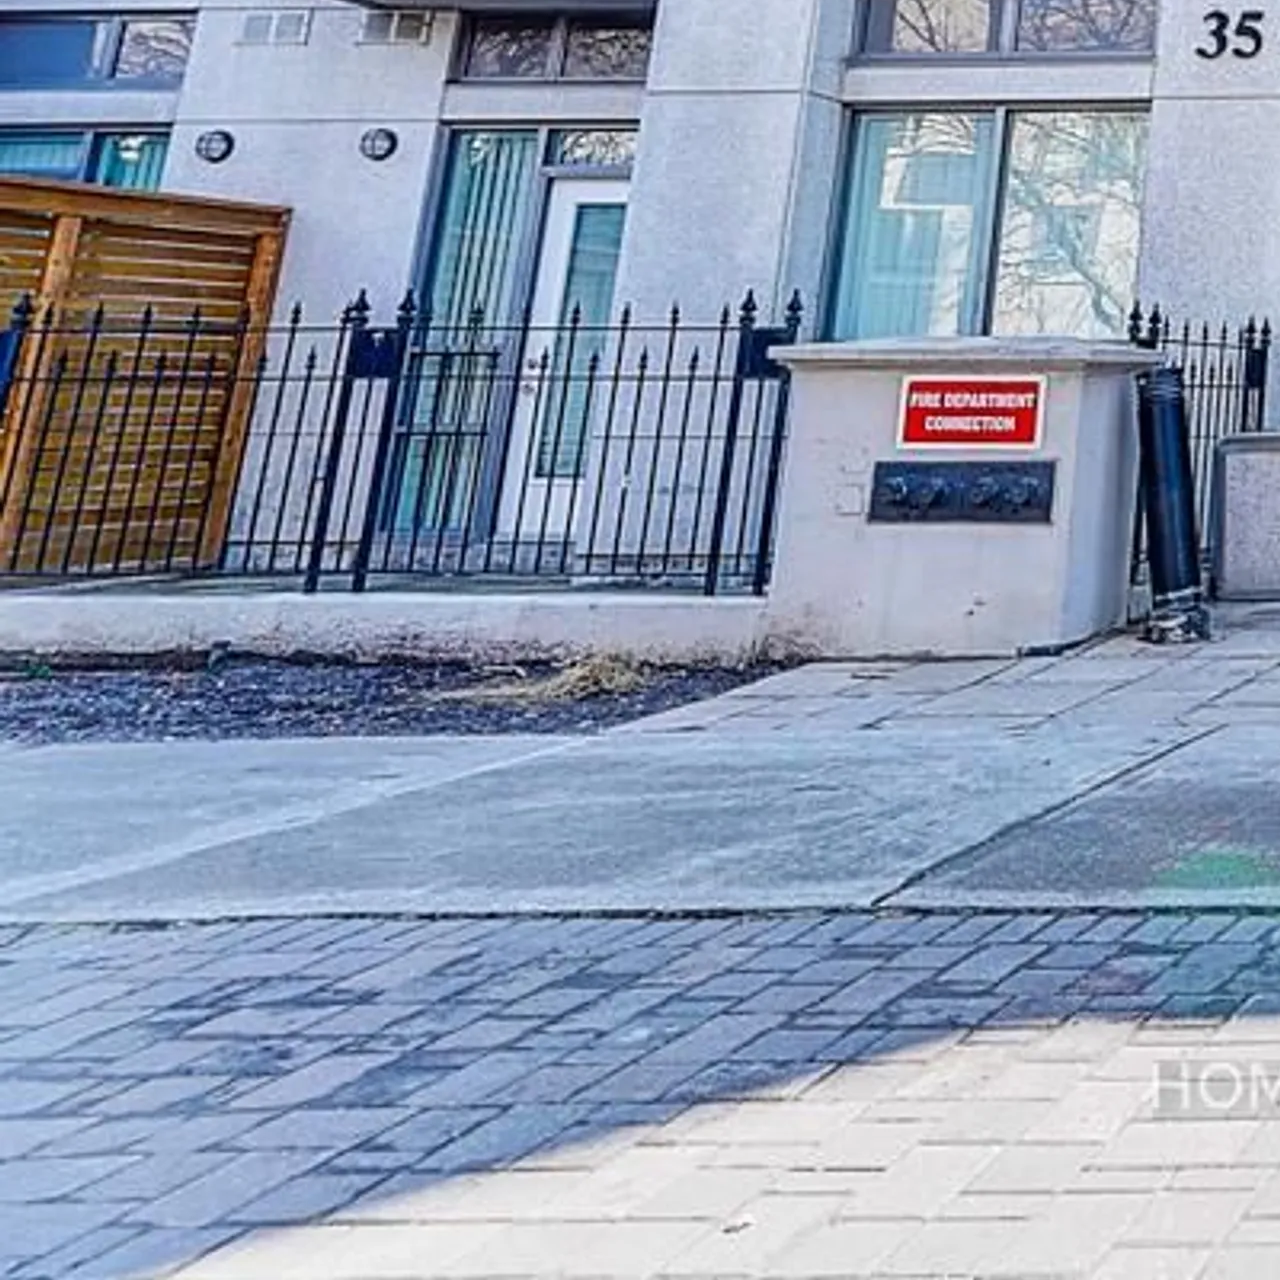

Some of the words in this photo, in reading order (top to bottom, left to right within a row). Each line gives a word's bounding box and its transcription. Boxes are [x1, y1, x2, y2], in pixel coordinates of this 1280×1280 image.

[1195, 9, 1264, 59] 35
[909, 391, 941, 408] FIRE
[944, 391, 1035, 408] DEPARTMENT
[924, 416, 1016, 432] CONNECTION
